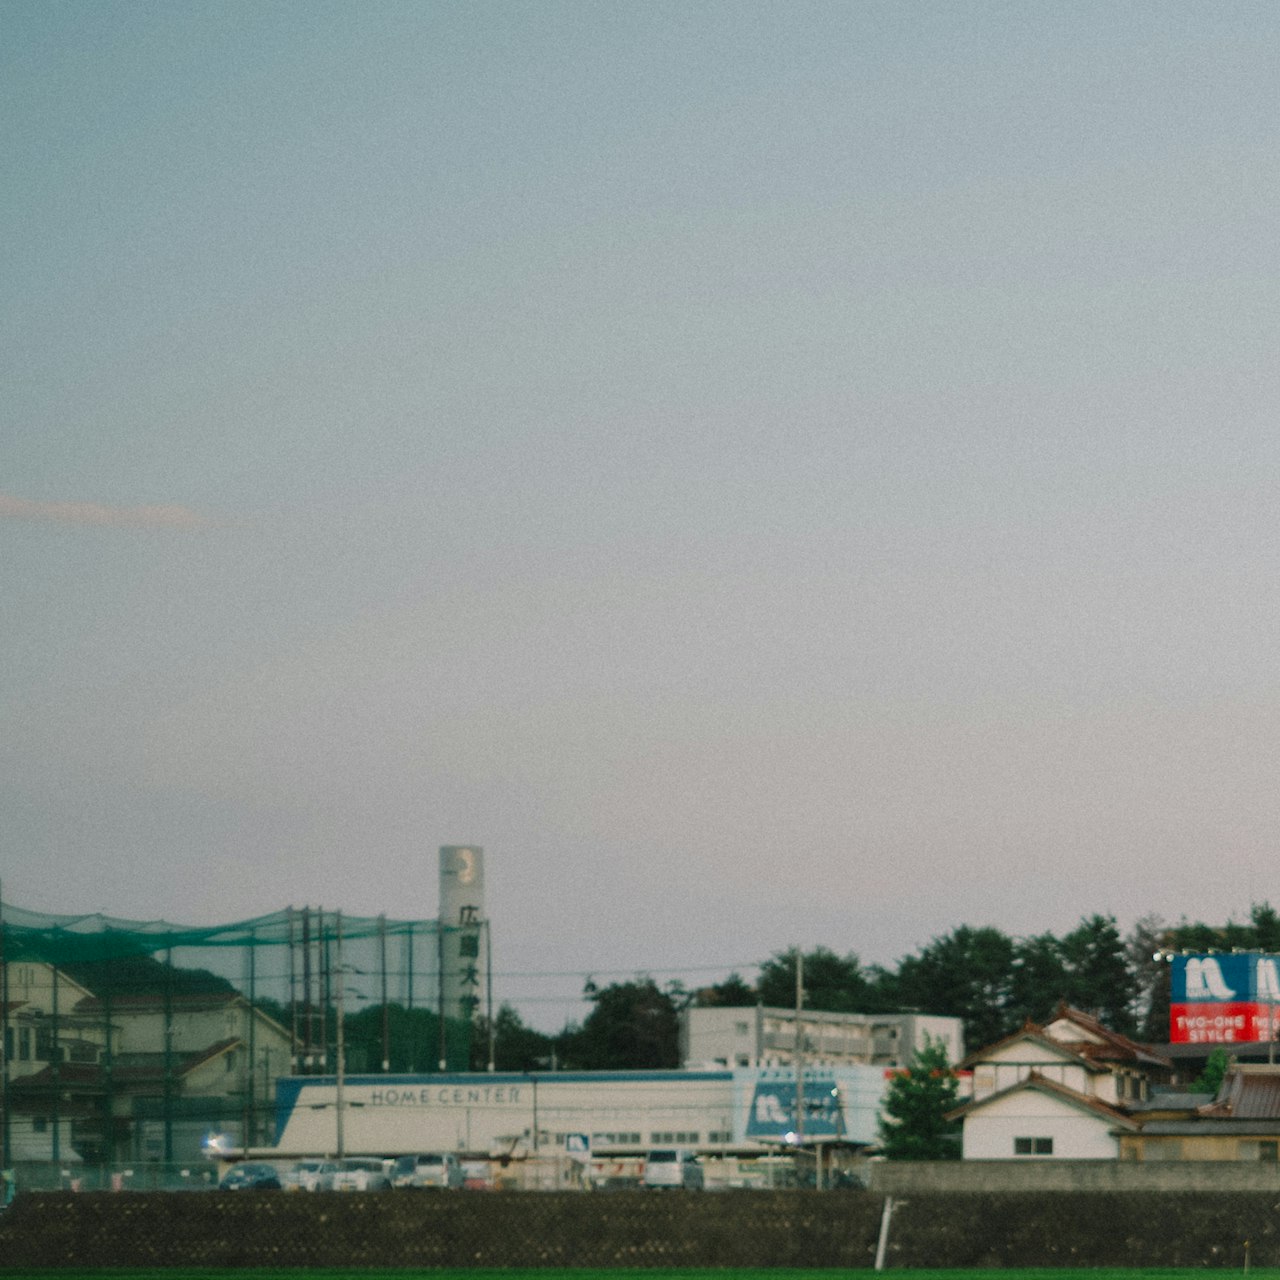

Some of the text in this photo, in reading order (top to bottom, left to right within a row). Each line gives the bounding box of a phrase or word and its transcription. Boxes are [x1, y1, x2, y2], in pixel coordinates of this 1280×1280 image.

[1176, 1015, 1245, 1029] TWO-ONE
[1189, 1029, 1234, 1042] STYLE
[371, 1087, 520, 1105] HOME CENTER
